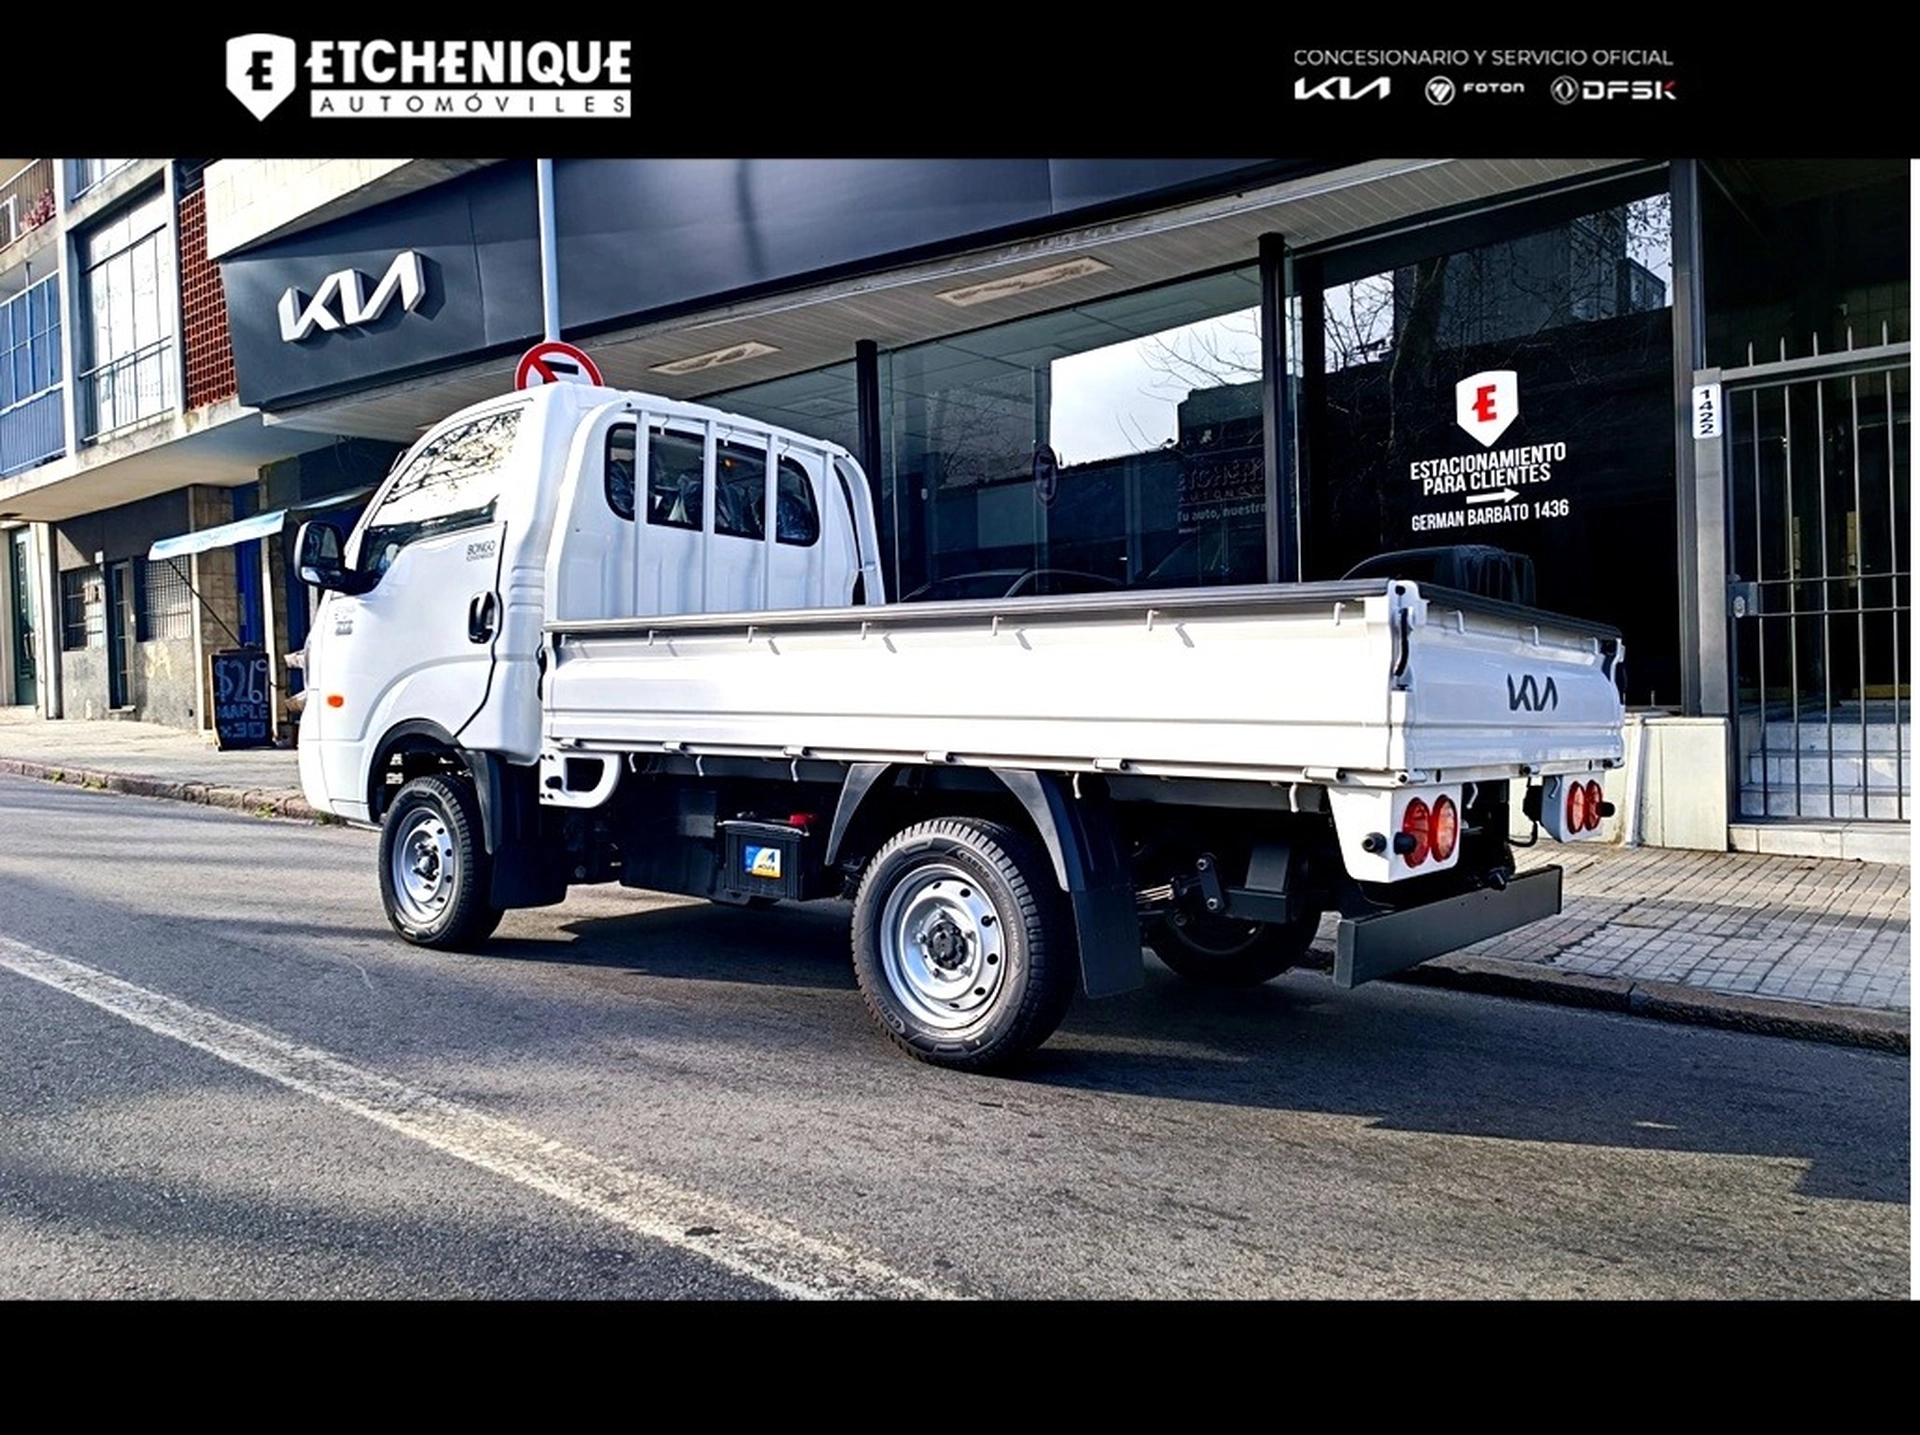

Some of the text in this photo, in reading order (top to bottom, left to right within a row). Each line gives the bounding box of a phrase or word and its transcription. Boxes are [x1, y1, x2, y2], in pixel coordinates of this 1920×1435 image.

[277, 249, 426, 343] KIA
[1698, 389, 1714, 436] 1422
[1410, 441, 1567, 481] ESTACIONAMIENTO
[1423, 462, 1552, 497] PARA CLIENTES
[1411, 498, 1570, 532] GERMAN BARBATO 1436
[1506, 672, 1559, 712] KIA
